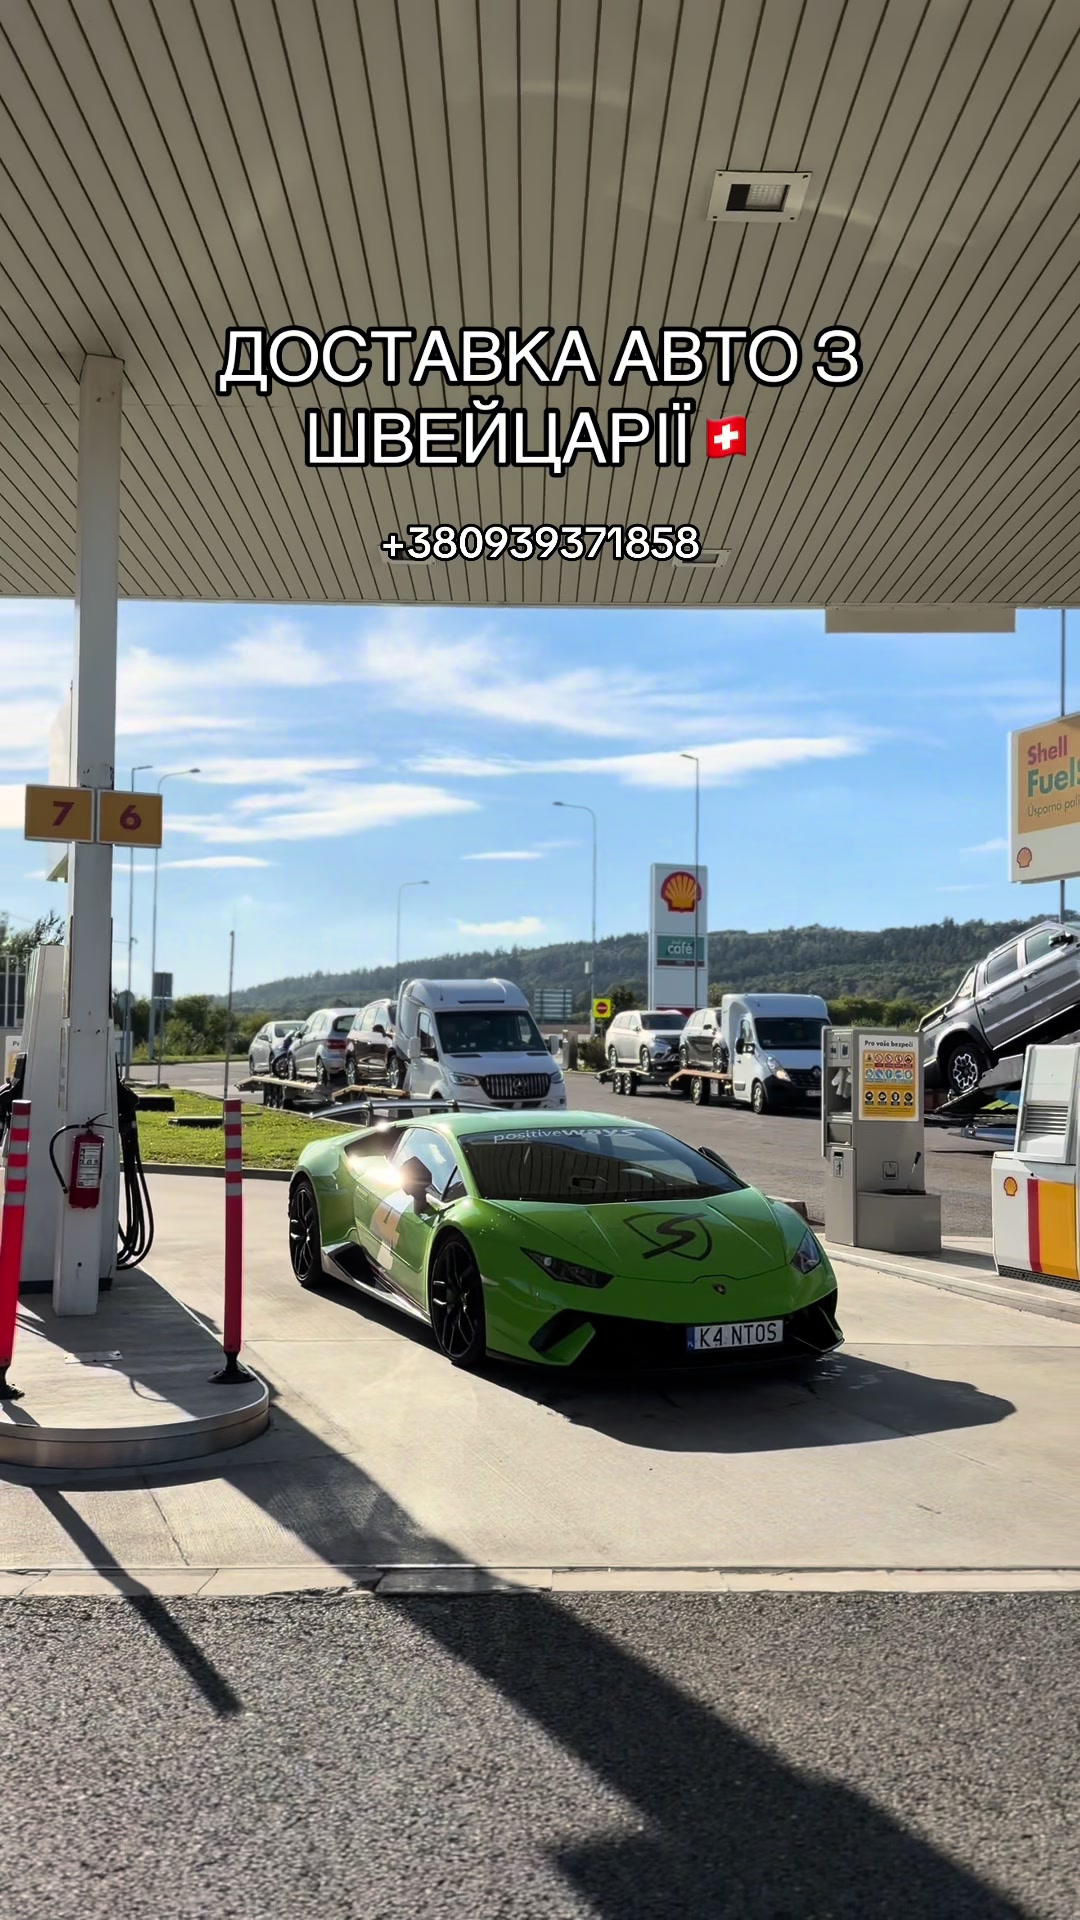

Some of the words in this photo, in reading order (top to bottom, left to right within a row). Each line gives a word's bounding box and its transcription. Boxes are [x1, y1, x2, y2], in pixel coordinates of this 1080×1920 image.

[1027, 734, 1068, 766] Shell
[53, 800, 75, 827] 7
[120, 804, 142, 830] 6
[667, 941, 693, 954] café
[493, 1128, 643, 1144] positiveways
[700, 1327, 723, 1348] K4
[731, 1322, 777, 1346] NTOS
